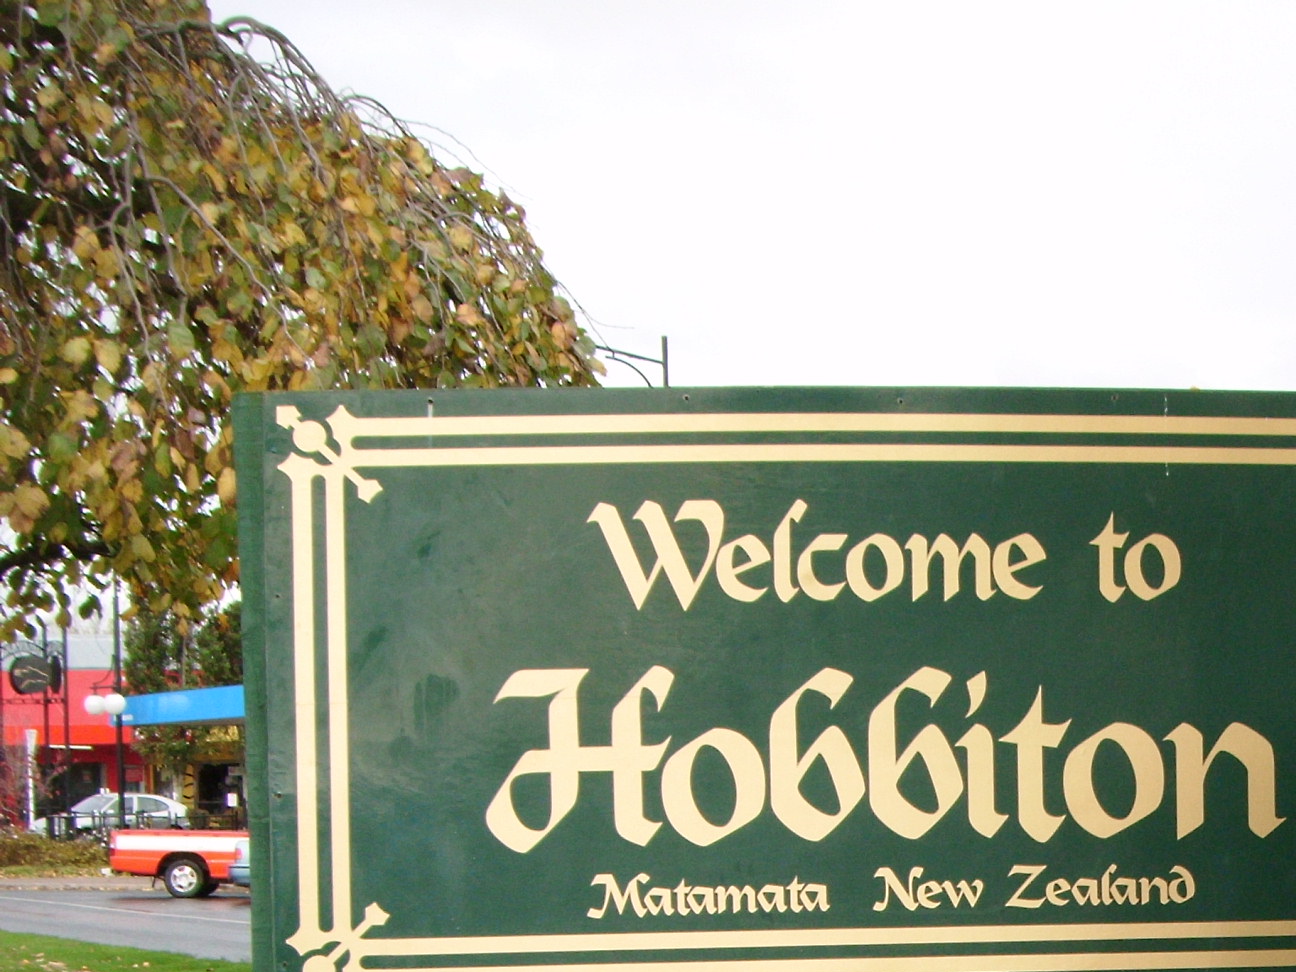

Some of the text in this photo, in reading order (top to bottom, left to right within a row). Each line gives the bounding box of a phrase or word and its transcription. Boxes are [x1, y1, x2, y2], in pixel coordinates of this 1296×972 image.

[586, 498, 1182, 611] Welcome to
[485, 665, 1287, 855] Hobbiton
[587, 863, 1197, 920] Matamata New Zealand
